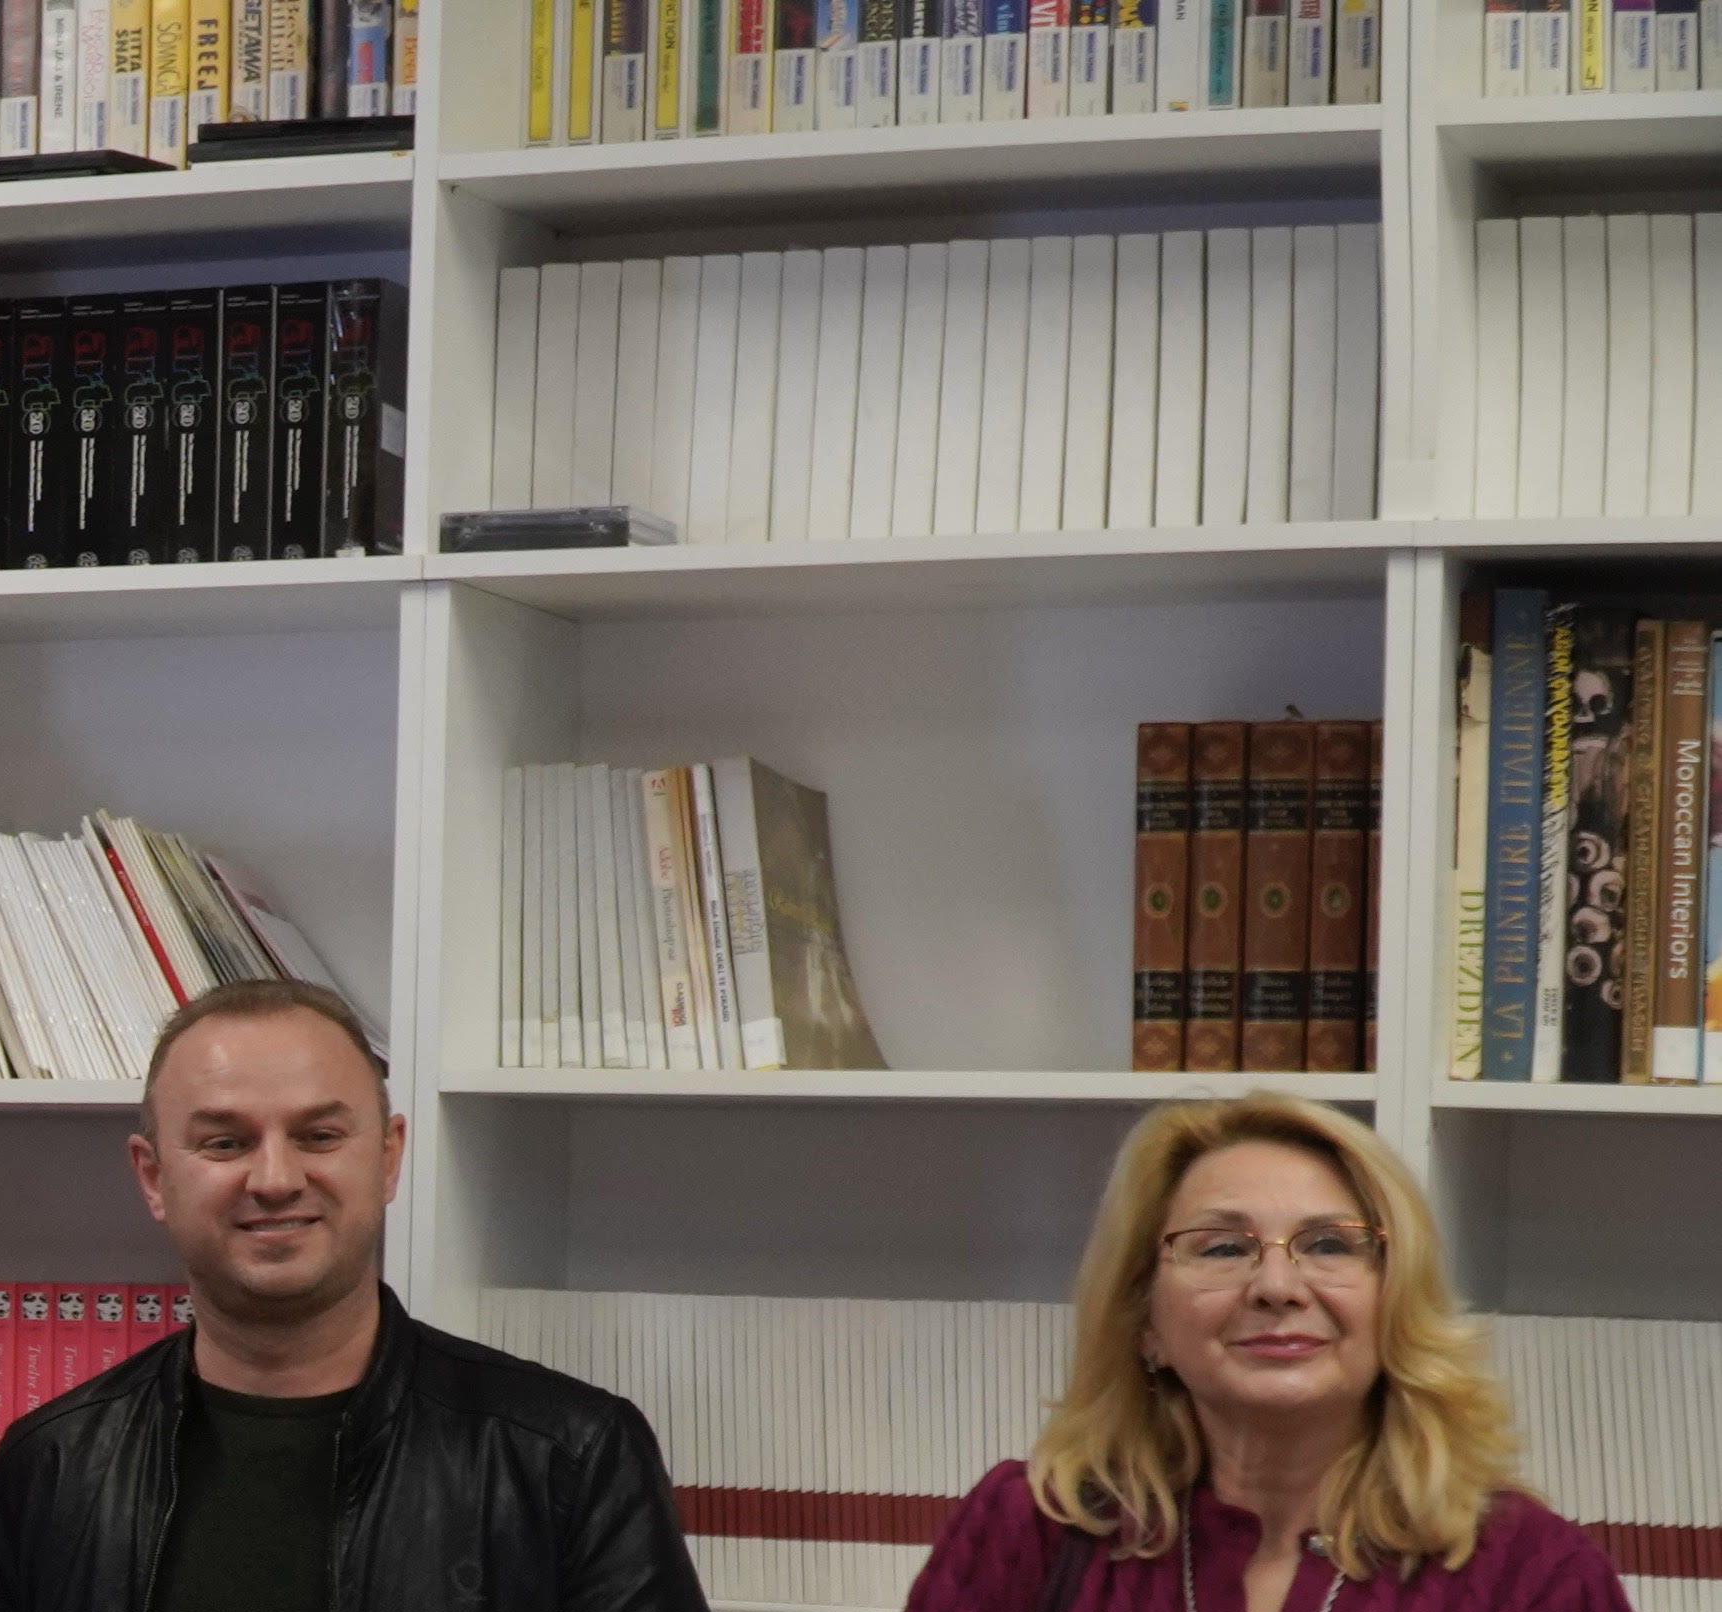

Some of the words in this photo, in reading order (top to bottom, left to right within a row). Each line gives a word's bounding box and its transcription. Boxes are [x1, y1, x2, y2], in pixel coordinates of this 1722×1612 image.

[130, 28, 142, 72] TITTA
[28, 410, 45, 435] 20
[131, 404, 148, 430] 20
[234, 400, 251, 425] 20
[1499, 630, 1537, 805] ITALIENNE
[1672, 738, 1701, 866] Moroccan
[1494, 823, 1532, 984] PEINTURE
[1669, 874, 1694, 979] Interiors
[1456, 890, 1485, 1063] DREZDEN
[1493, 1003, 1526, 1039] LA
[27, 1345, 41, 1389] Twelve
